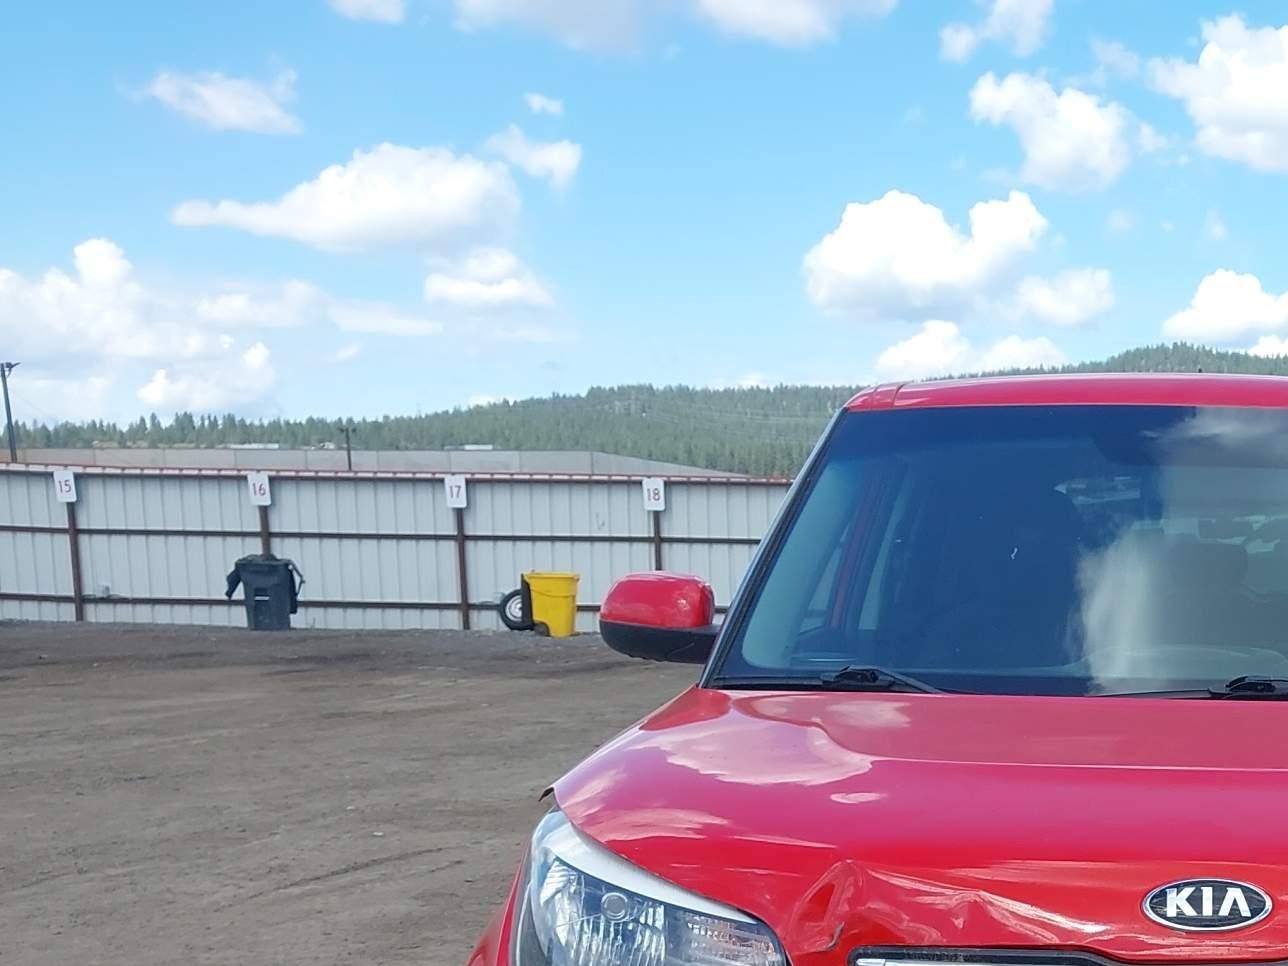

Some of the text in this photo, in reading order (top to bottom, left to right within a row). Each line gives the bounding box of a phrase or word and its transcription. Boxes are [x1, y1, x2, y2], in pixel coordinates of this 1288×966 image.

[58, 479, 72, 493] 15
[252, 482, 266, 496] 16
[449, 485, 462, 498] 17
[646, 487, 660, 501] 18
[1165, 886, 1252, 917] KIA
